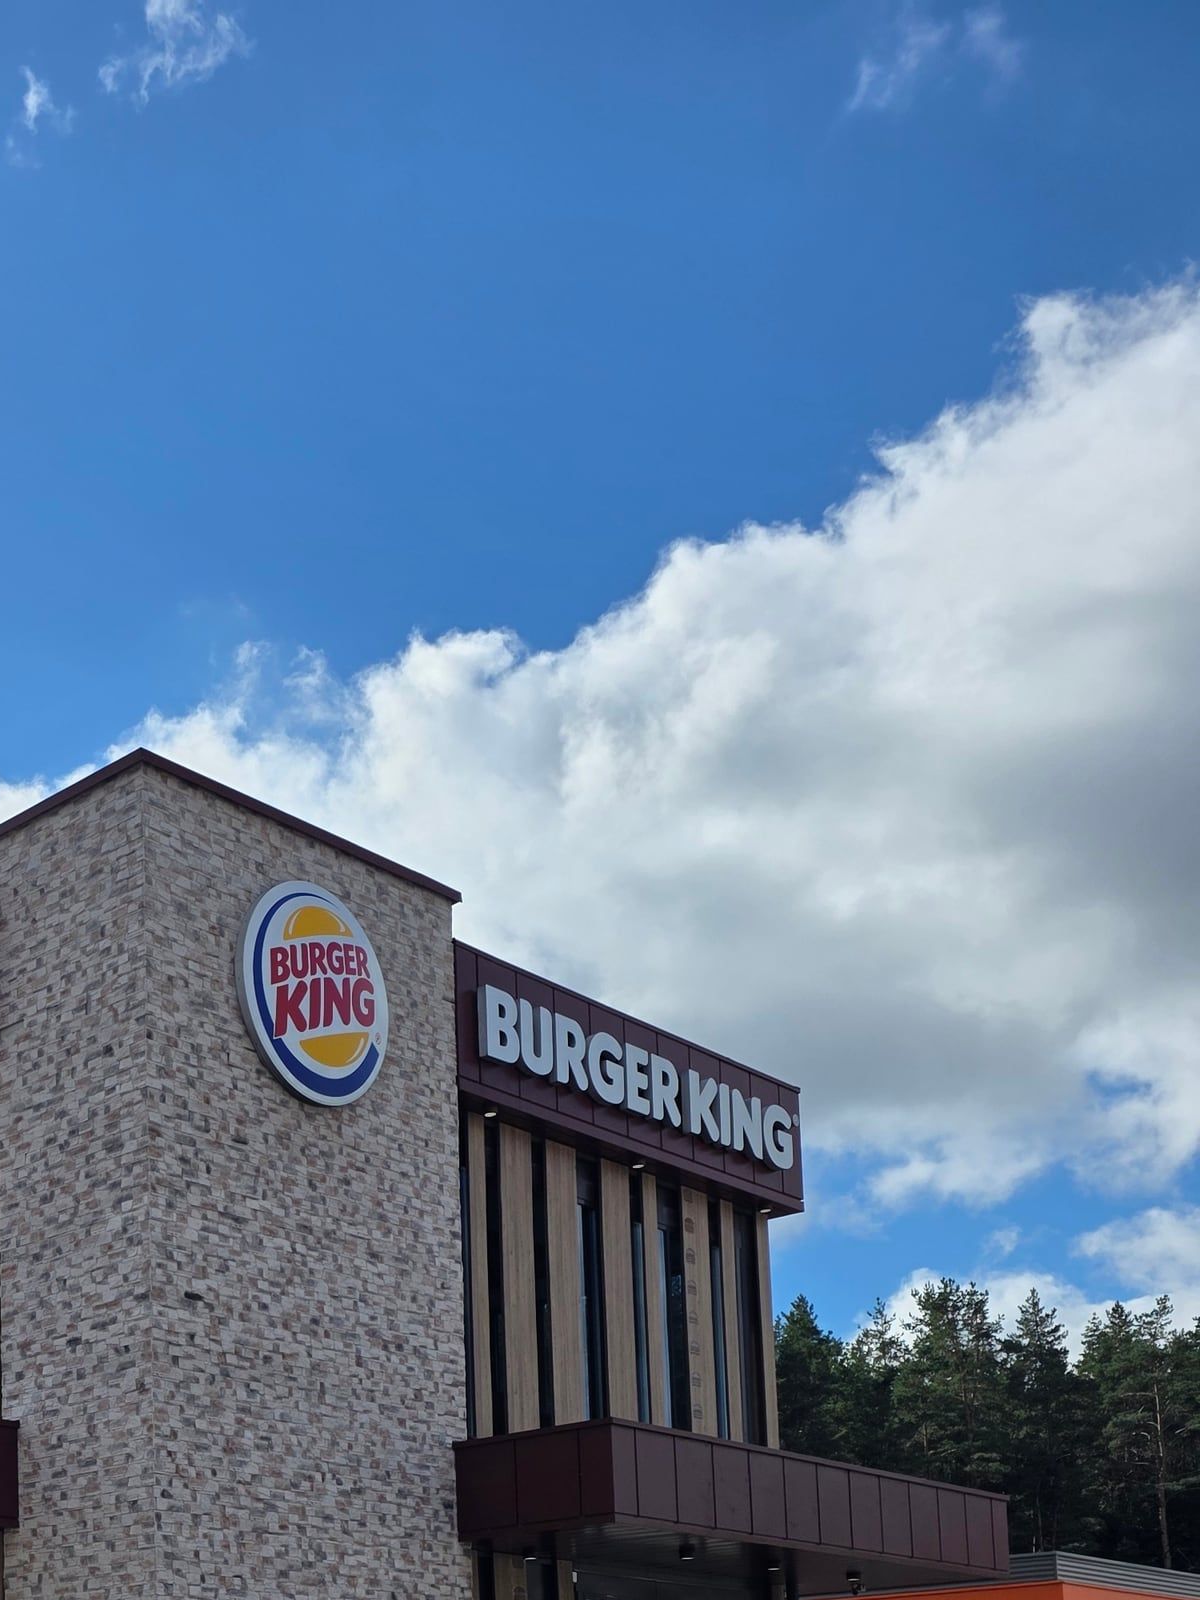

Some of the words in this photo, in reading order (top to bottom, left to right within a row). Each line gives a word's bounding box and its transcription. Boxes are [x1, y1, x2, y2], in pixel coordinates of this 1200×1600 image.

[270, 941, 370, 985] BURGER
[273, 977, 376, 1038] KING
[478, 984, 682, 1128] BURGER
[682, 1068, 794, 1171] KING
